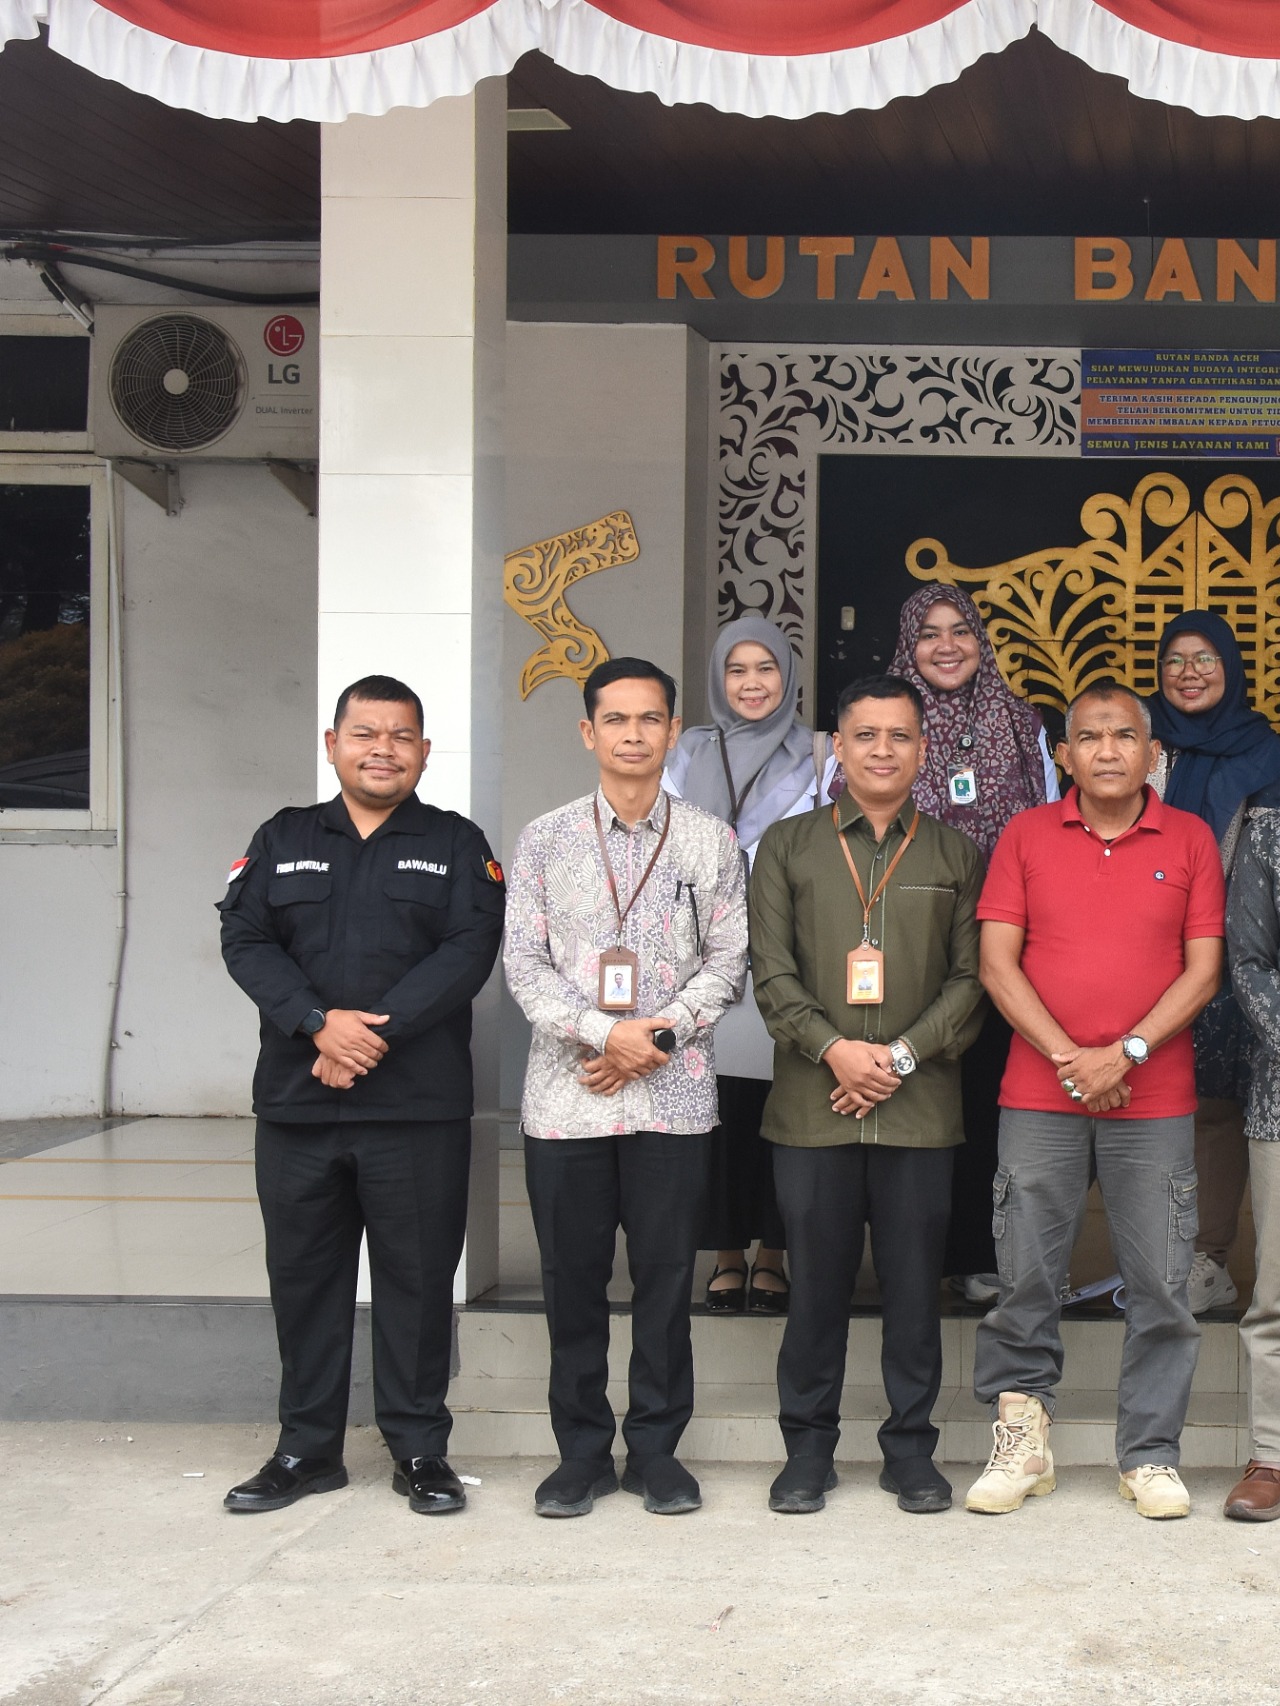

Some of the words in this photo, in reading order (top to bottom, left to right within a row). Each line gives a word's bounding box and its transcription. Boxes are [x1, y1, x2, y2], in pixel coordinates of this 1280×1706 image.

[656, 236, 990, 300] RUTAN
[1155, 353, 1192, 362] RUTAN
[1194, 354, 1230, 362] BANDA
[1232, 354, 1260, 363] ACEH
[267, 363, 301, 385] LG
[1090, 365, 1116, 373] SIAP
[1117, 365, 1190, 374] MEWUJUDKAN
[1192, 366, 1234, 374] BUDAYA
[1086, 376, 1149, 385] PELAYANAN
[1151, 376, 1187, 385] TANPA
[1189, 377, 1258, 386] GRATIFIKASI
[1099, 395, 1139, 404] TERIMA
[1141, 395, 1174, 404] KASIH
[1176, 396, 1217, 404] KEPADA
[254, 405, 278, 415] DUAL
[280, 405, 314, 415] Inverter
[1117, 406, 1150, 415] TELAH
[1152, 406, 1227, 415] BERKOMITMEN
[1229, 407, 1264, 416] UNTUK
[1086, 417, 1157, 426] MEMBERIKAN
[1159, 418, 1206, 427] IMBALAN
[1208, 418, 1249, 427] KEPADA
[1086, 440, 1131, 449] SEMUA
[1133, 440, 1169, 451] JENIS
[1171, 440, 1232, 450] LAYANAN
[1235, 441, 1270, 450] KAMI
[397, 859, 448, 876] BAWASLU
